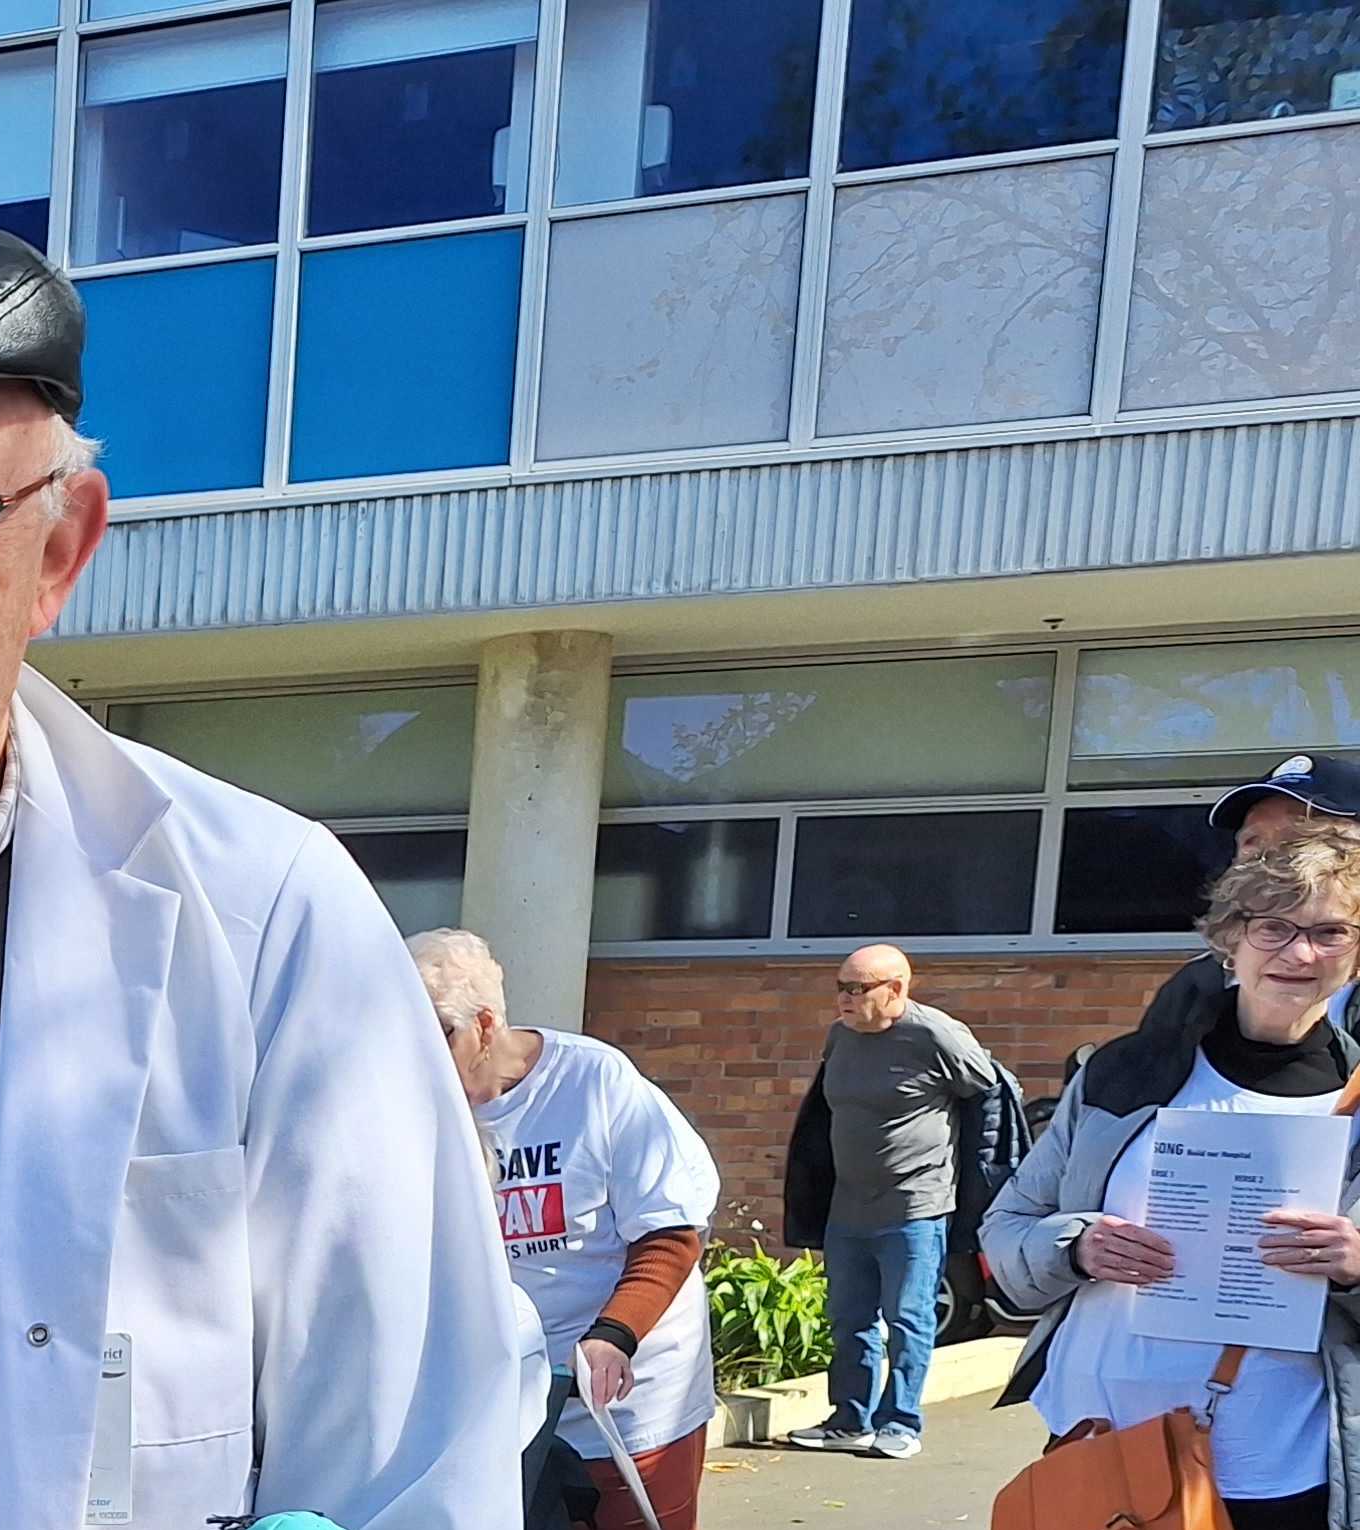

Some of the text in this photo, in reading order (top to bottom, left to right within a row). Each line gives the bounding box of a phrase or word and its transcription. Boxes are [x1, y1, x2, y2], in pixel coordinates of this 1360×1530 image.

[495, 1141, 562, 1184] SAVE
[526, 1236, 568, 1256] HURT
[103, 1348, 123, 1359] rict
